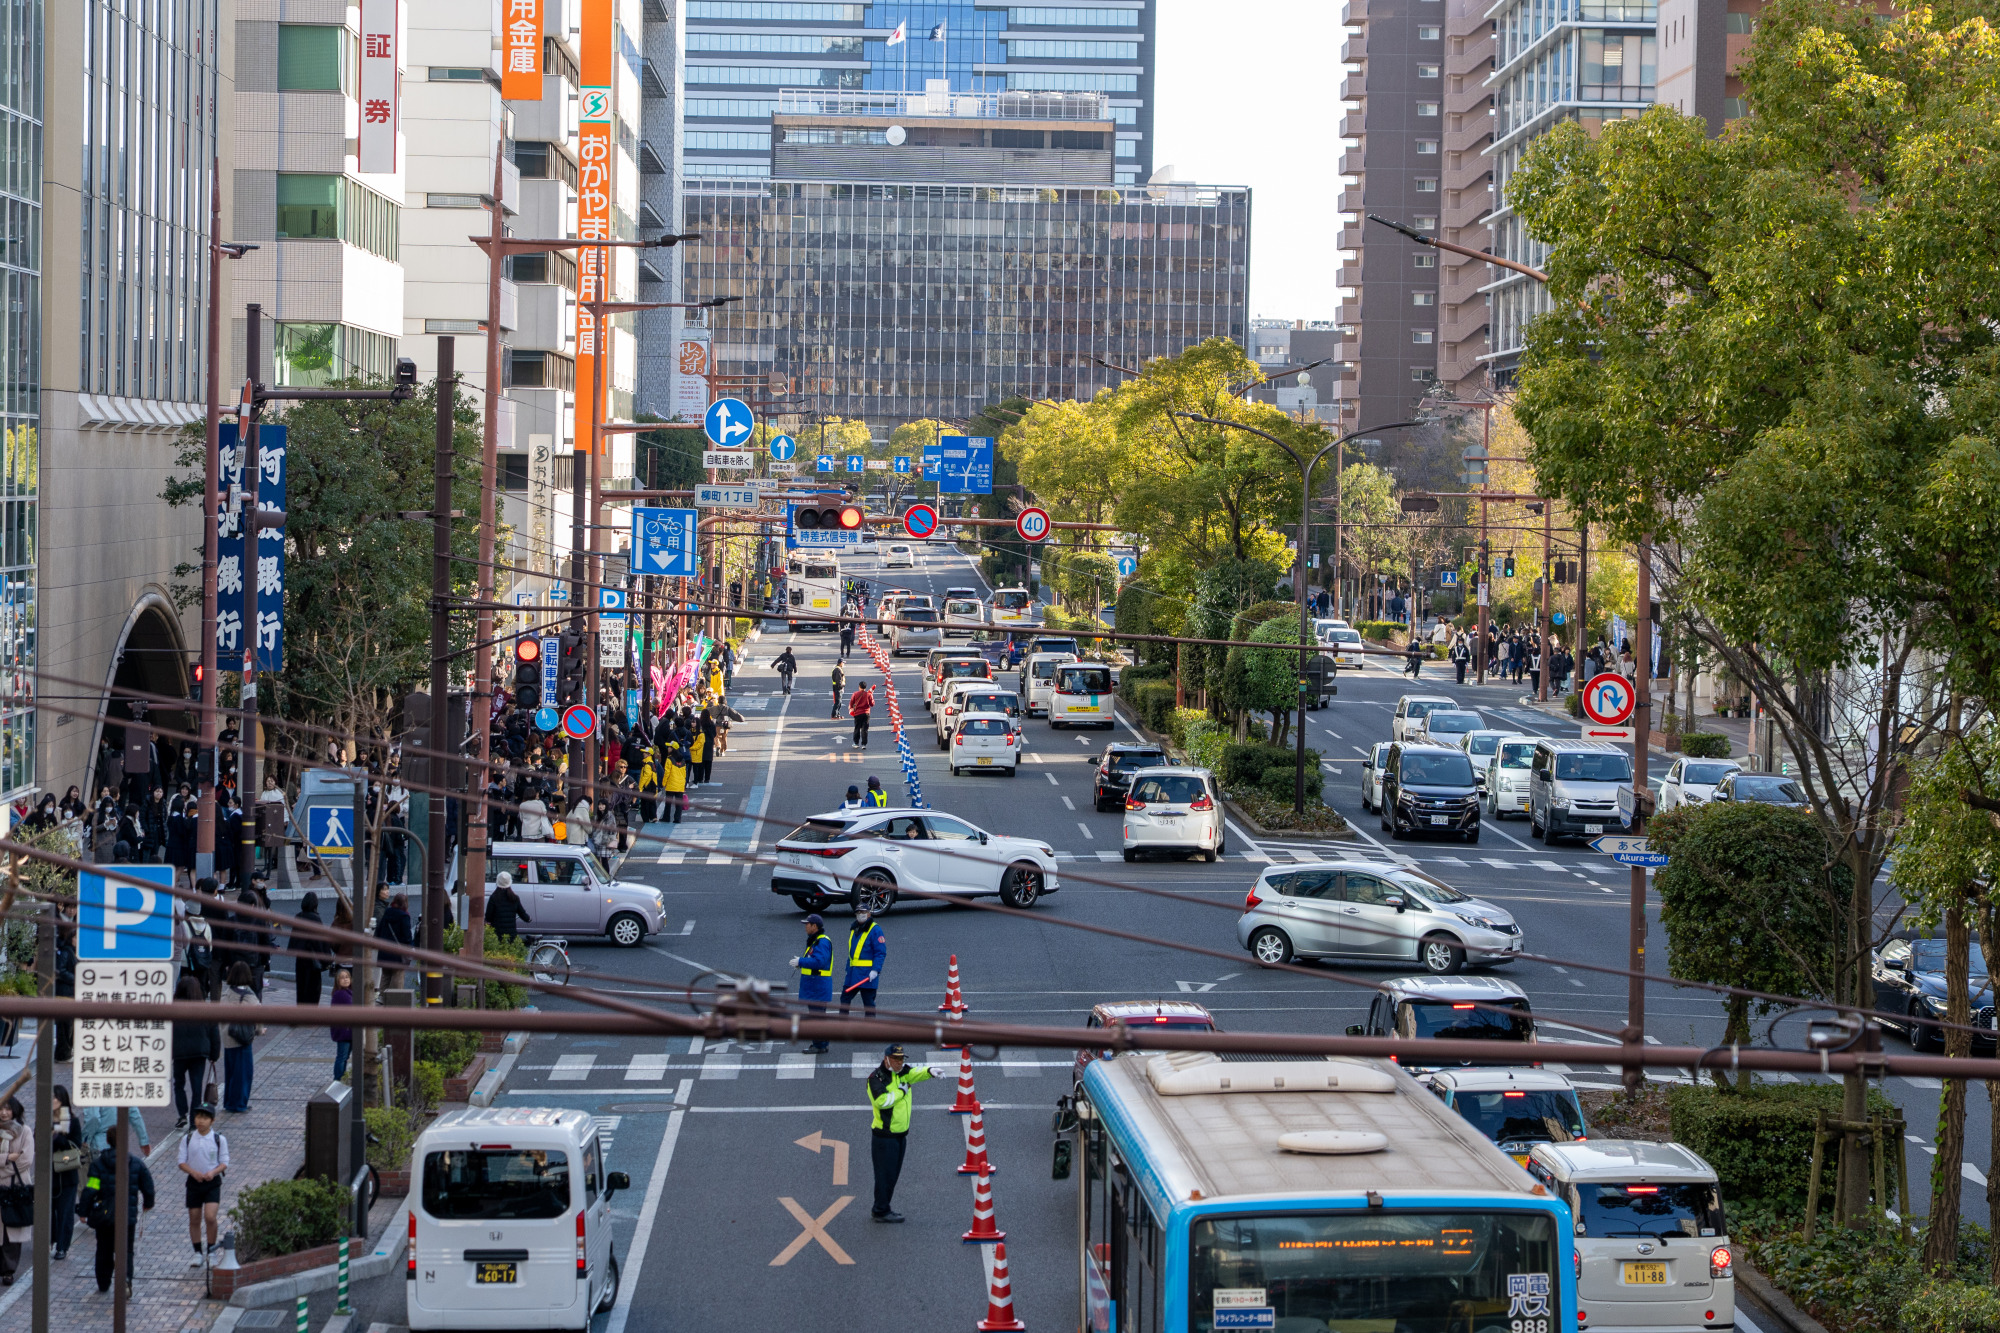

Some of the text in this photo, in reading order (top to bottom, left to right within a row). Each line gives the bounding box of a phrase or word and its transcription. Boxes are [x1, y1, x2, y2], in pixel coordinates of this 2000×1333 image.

[365, 34, 392, 124] 証券
[706, 455, 751, 467] 自転車を除く
[700, 490, 754, 504] 柳町1丁目
[1024, 516, 1044, 532] 40
[648, 535, 680, 550] 専用
[799, 530, 859, 544] 時差式信号機
[602, 590, 620, 616] P
[600, 621, 624, 629] -19の
[544, 641, 558, 704] 自転車専用
[1619, 853, 1665, 864] Akura-dori
[103, 876, 157, 950] P
[82, 968, 168, 987] 9-19の
[81, 1034, 166, 1052] 3t以下の
[80, 1056, 165, 1074] 貨物に限る
[79, 1081, 165, 1100] 表示線部分に限る
[484, 1270, 516, 1282] 60-17
[1635, 1271, 1664, 1282] 11-88
[1507, 1273, 1551, 1297] 岡電
[1508, 1295, 1551, 1318] バス
[1511, 1319, 1548, 1333] 988
